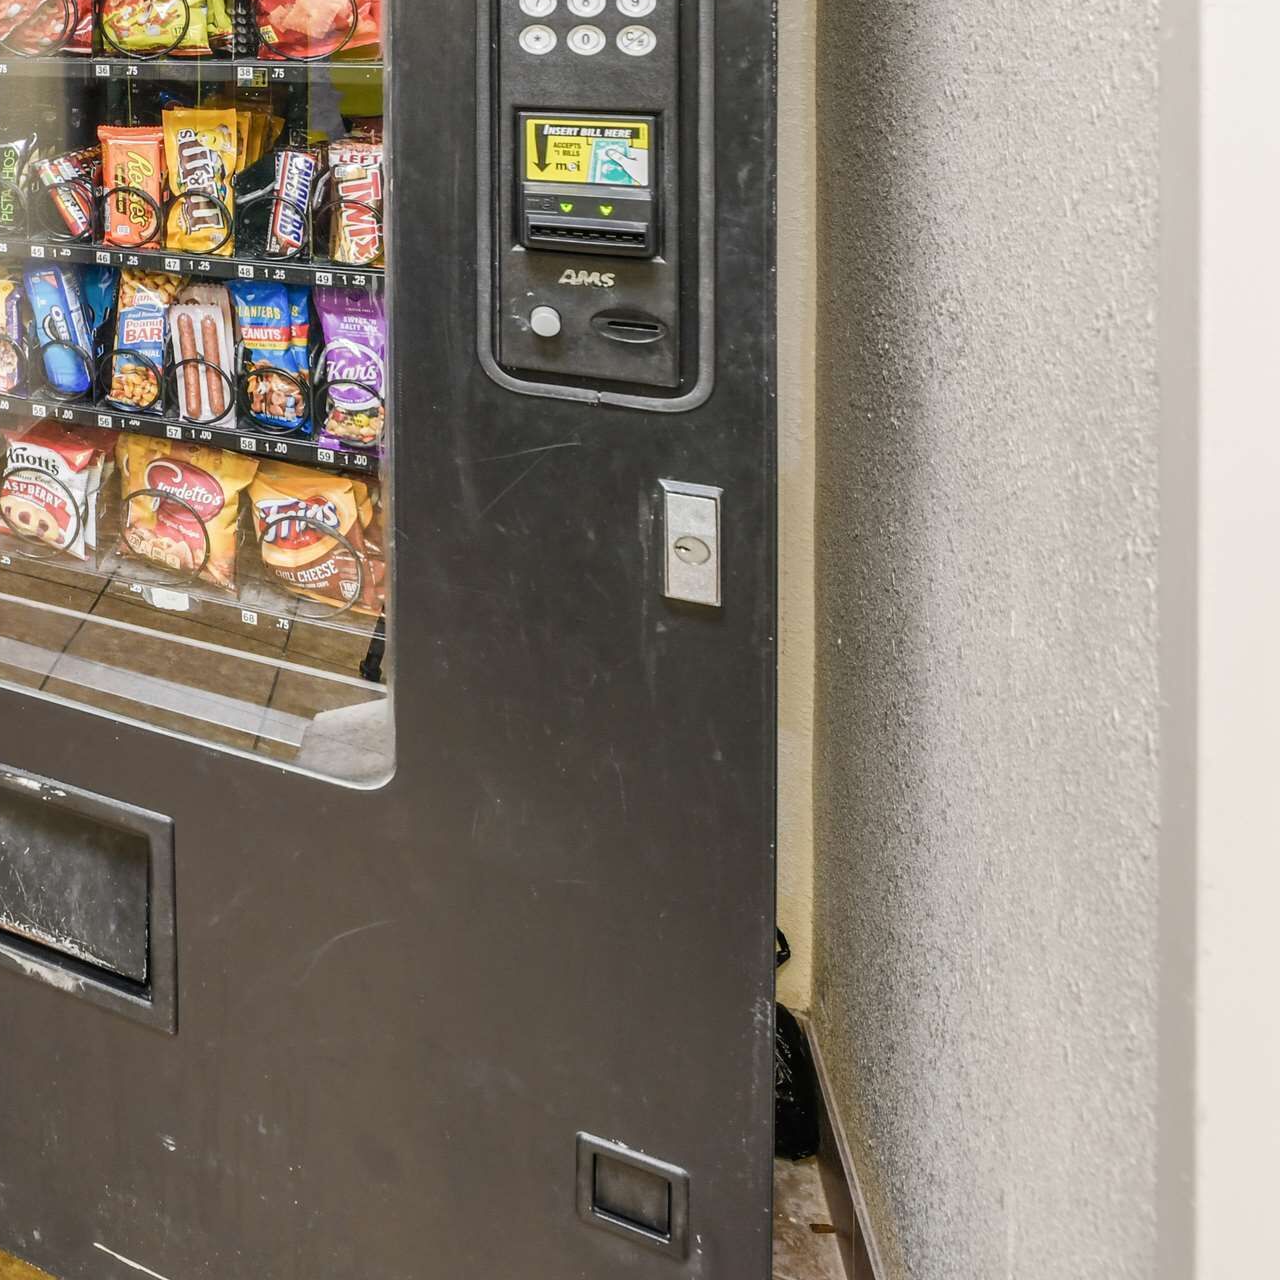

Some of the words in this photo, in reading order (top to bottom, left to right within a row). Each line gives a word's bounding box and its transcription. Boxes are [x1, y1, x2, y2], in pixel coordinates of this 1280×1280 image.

[582, 33, 590, 45] 0
[126, 65, 138, 76] .75
[239, 68, 251, 77] 38
[271, 68, 285, 78] .75
[543, 124, 579, 136] INSERT
[580, 126, 603, 137] BILL
[604, 128, 633, 138] HERE
[553, 142, 582, 150] ACCEPTS
[339, 153, 380, 165] LEFT
[555, 160, 581, 172] mei
[1, 149, 16, 222] PISTAHIOS
[339, 170, 382, 259] TWIX
[97, 253, 109, 263] 46
[127, 255, 139, 266] .25
[166, 260, 178, 270] 47
[198, 261, 210, 271] .25
[240, 266, 251, 276] 48
[273, 269, 286, 280] .25
[557, 269, 616, 288] AMS
[317, 275, 329, 284] 49
[352, 275, 366, 286] .25
[50, 305, 71, 343] ORE
[126, 318, 163, 329] Peanut
[124, 327, 163, 343] BAR
[241, 326, 281, 341] EANUTS
[33, 406, 45, 416] 55
[62, 409, 74, 420] .00
[98, 416, 110, 426] 56
[167, 427, 179, 437] 57
[199, 429, 212, 440] .00
[241, 438, 254, 449] 58
[274, 442, 288, 454] .00
[7, 446, 60, 477] Knott's
[318, 451, 331, 462] 59
[354, 455, 368, 466] .00
[3, 479, 64, 510] ASPBERRY
[297, 559, 339, 583] CHEESE
[243, 613, 255, 623] 68
[276, 618, 290, 630] .75
